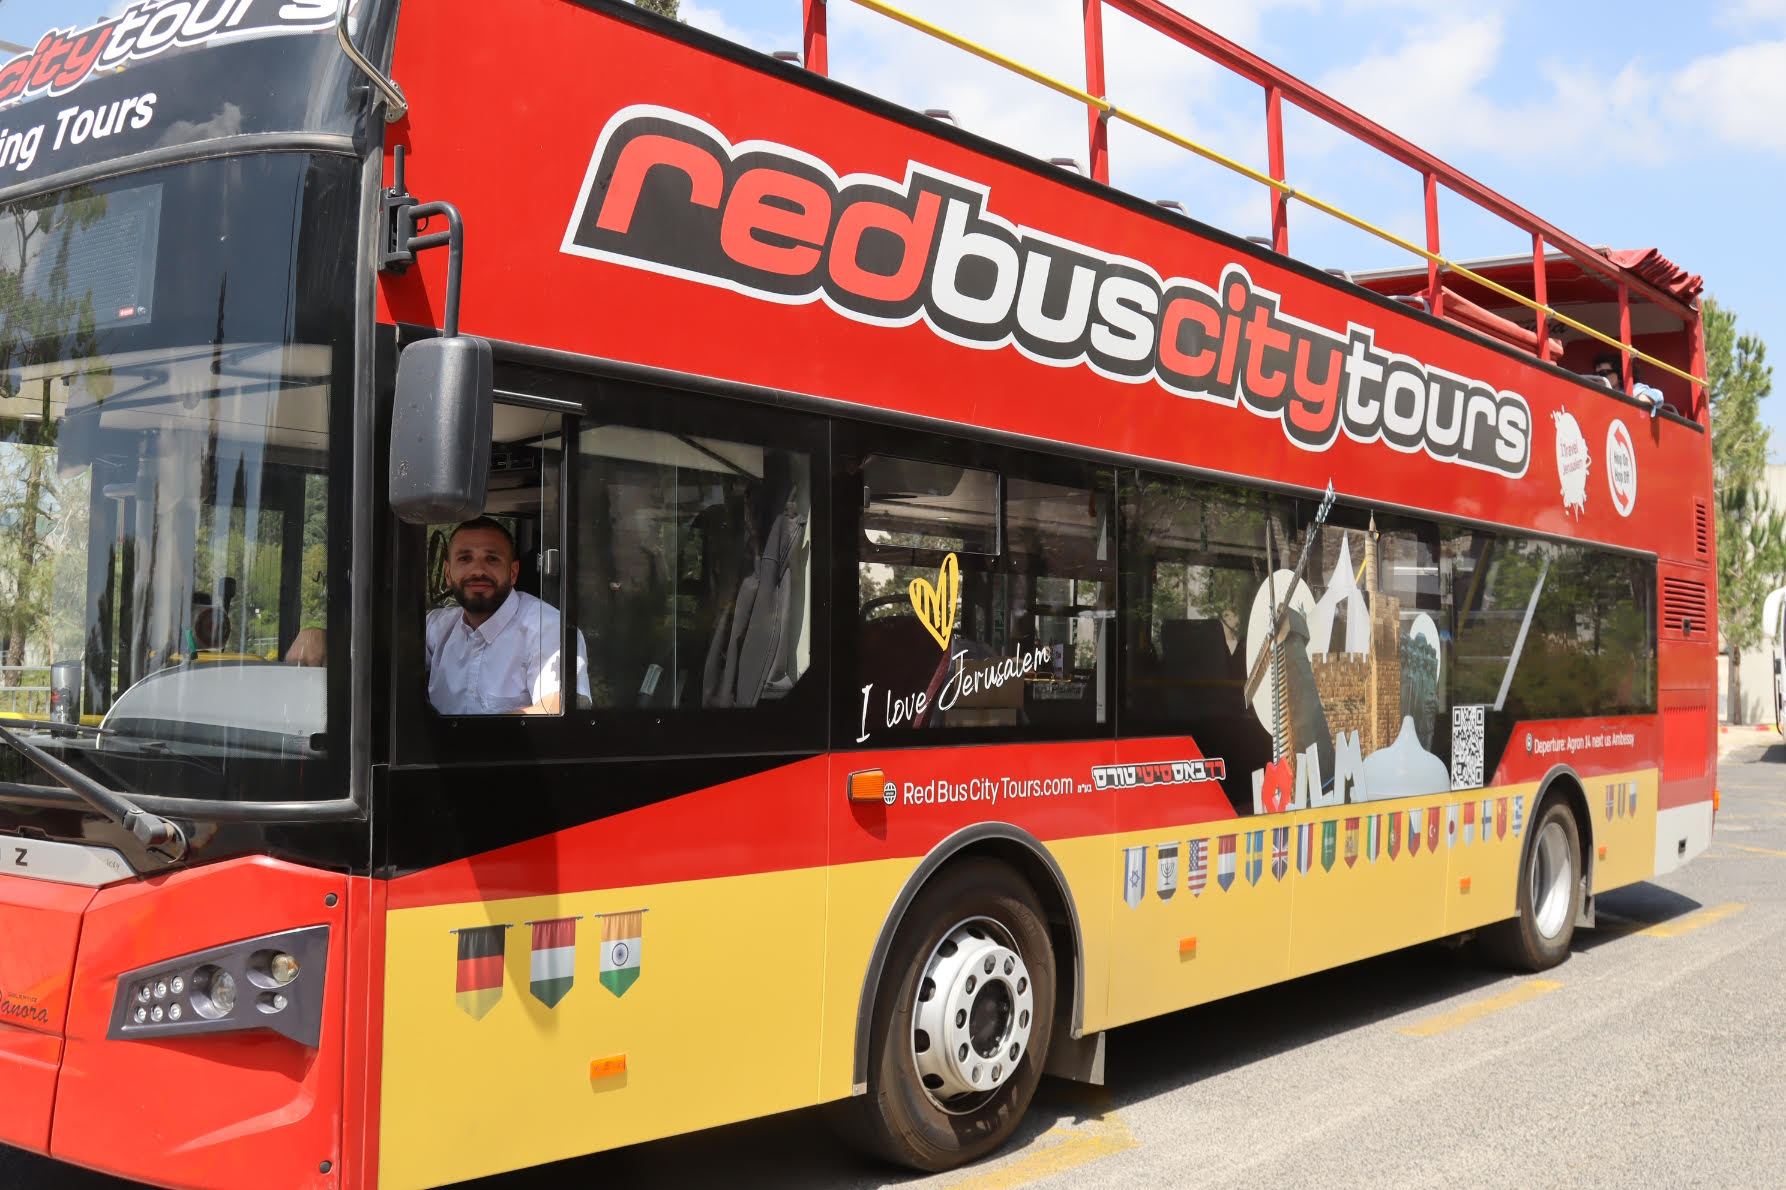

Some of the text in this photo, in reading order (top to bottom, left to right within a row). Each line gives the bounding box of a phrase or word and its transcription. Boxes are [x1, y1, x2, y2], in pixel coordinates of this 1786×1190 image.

[53, 93, 157, 150] Tours
[856, 684, 873, 743] I
[886, 689, 931, 728] love
[938, 642, 1050, 711] Jerusalem
[0, 993, 48, 1024] anora
